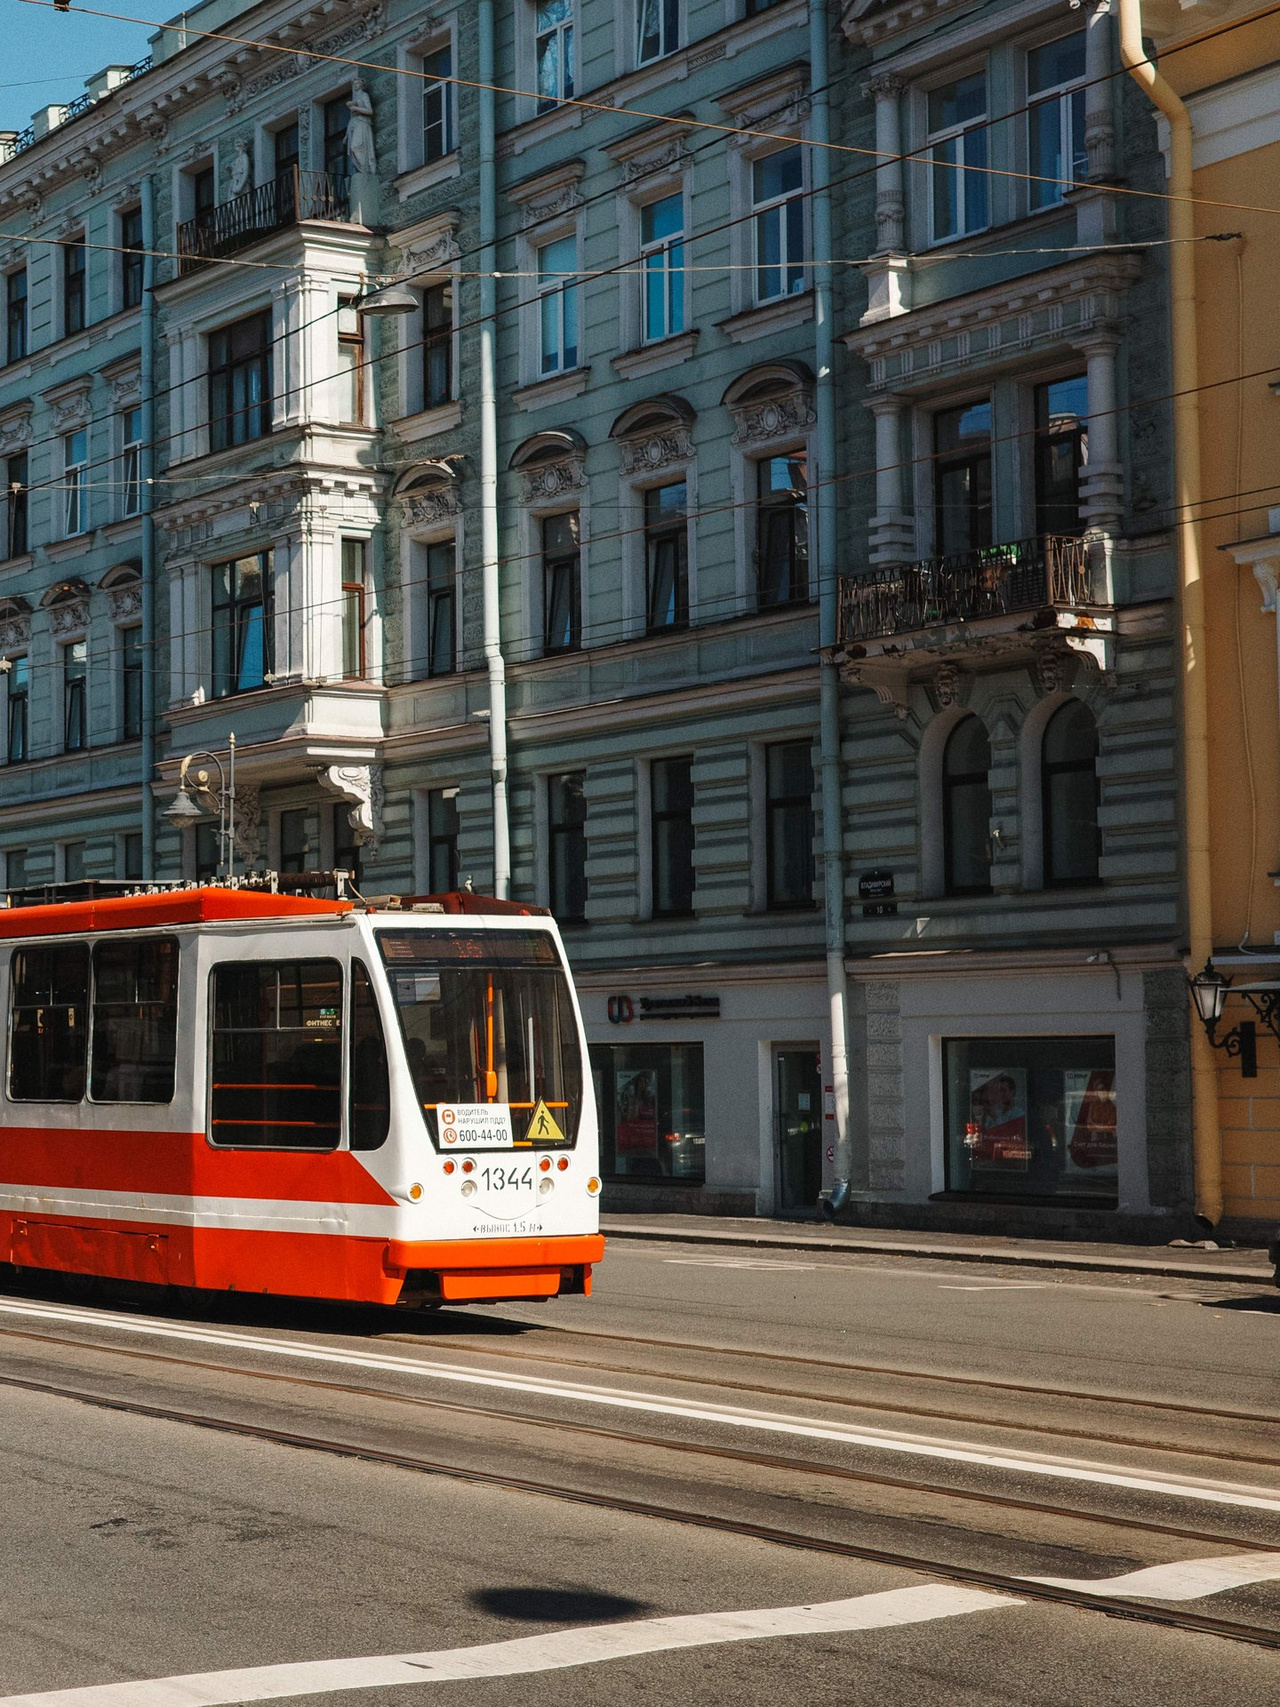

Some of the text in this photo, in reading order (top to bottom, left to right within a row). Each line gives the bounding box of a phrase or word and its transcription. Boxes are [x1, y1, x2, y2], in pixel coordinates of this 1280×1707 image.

[457, 1108, 489, 1117] ВОДИТЕЛЬ
[457, 1117, 489, 1125] НАРУШИЛ
[459, 1129, 508, 1142] 600-44-00
[481, 1167, 533, 1191] 1344
[480, 1223, 511, 1233] ВЫНОС
